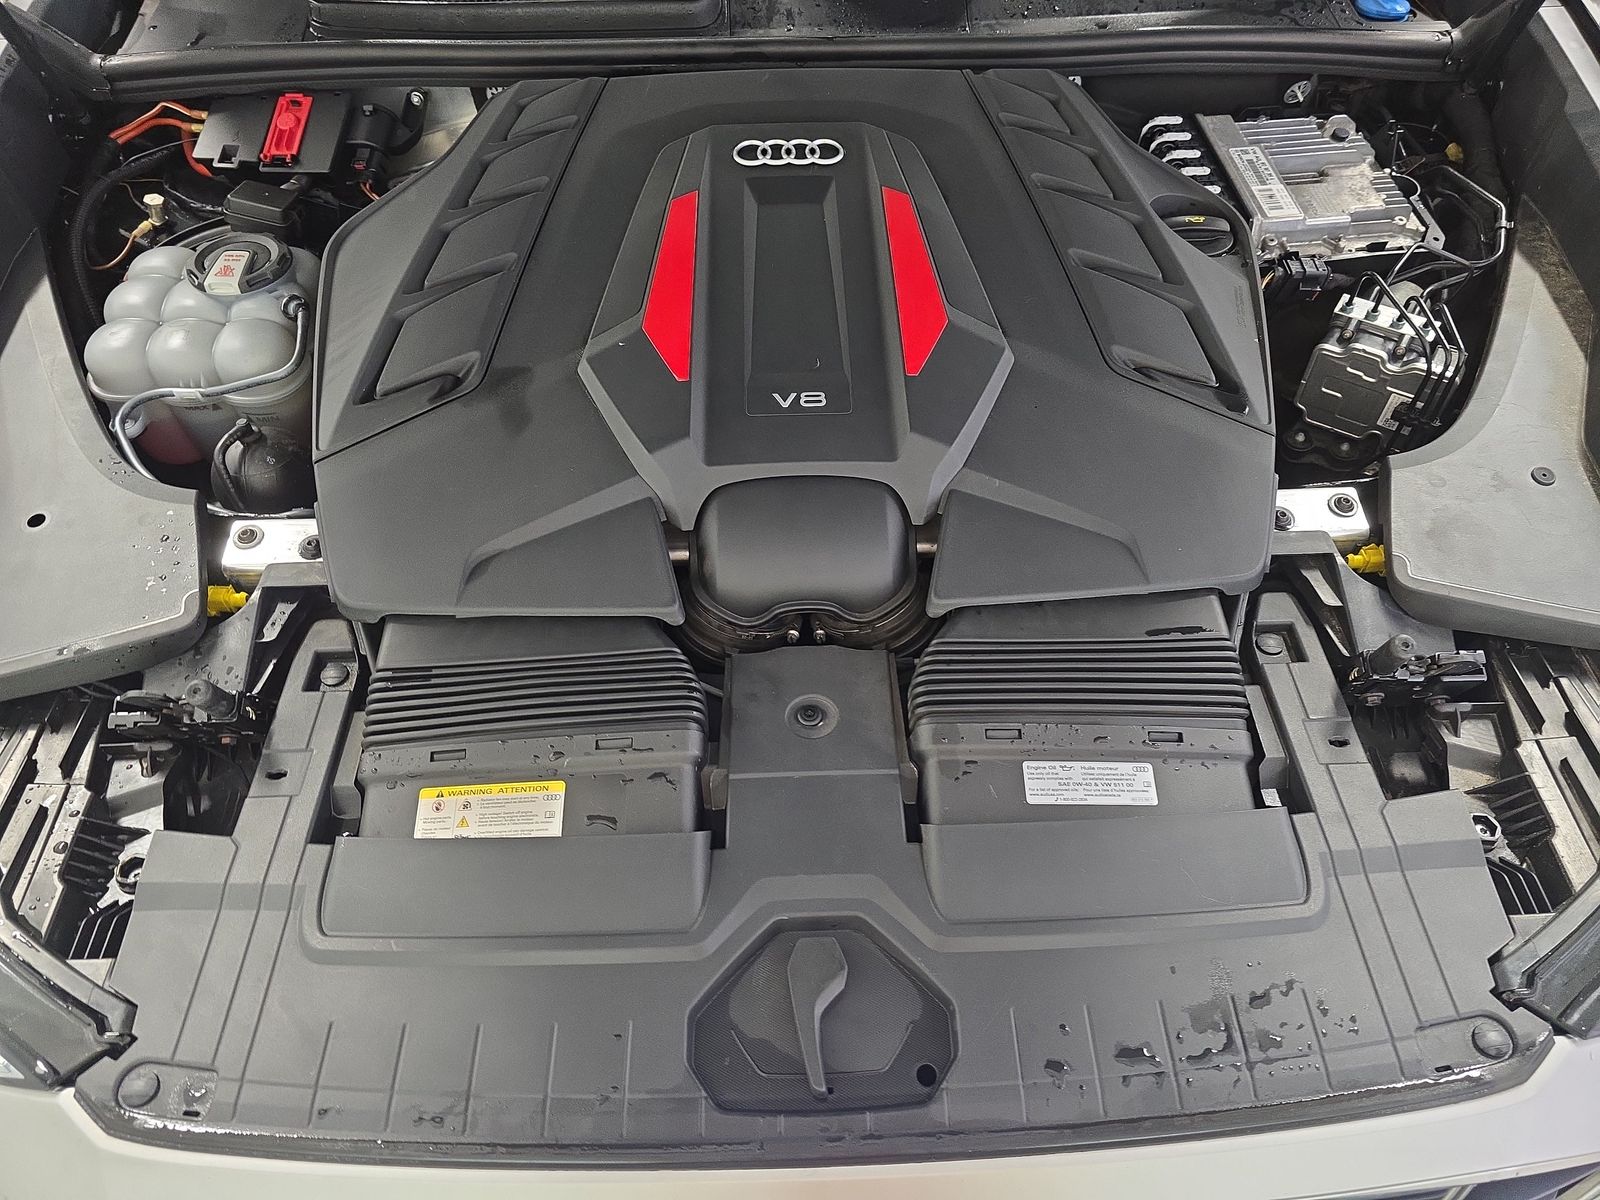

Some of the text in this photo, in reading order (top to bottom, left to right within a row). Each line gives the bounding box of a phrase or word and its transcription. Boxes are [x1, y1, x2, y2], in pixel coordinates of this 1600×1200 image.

[771, 391, 827, 408] V8
[447, 785, 550, 797] WARNING ATTENTION
